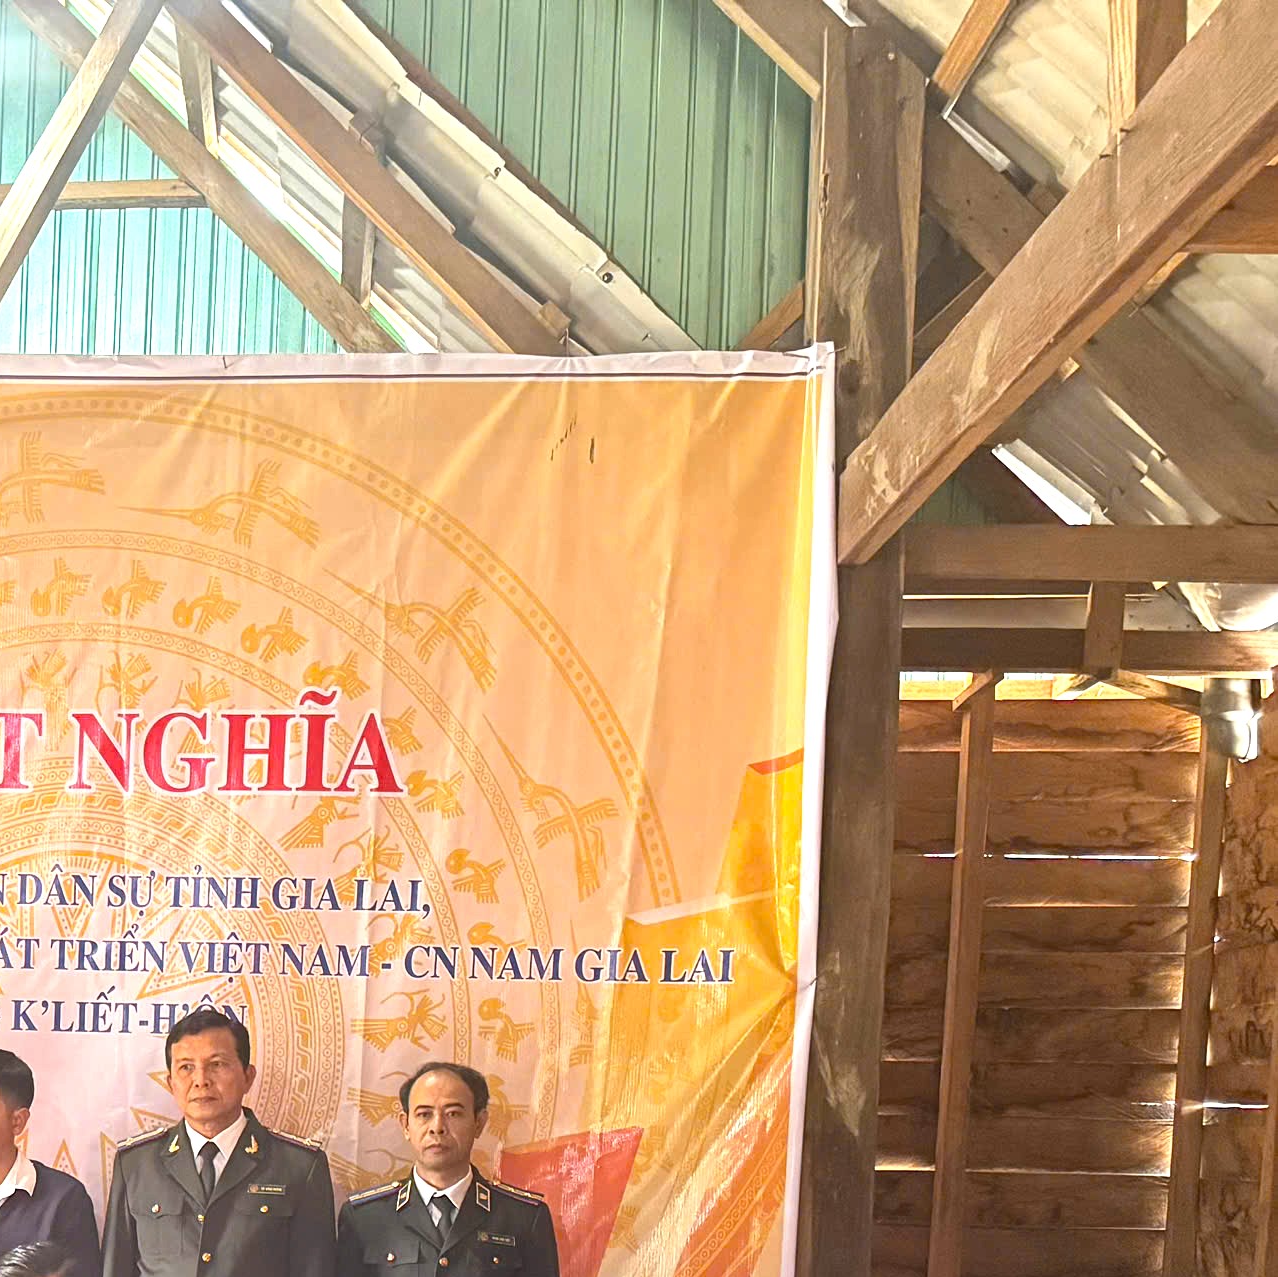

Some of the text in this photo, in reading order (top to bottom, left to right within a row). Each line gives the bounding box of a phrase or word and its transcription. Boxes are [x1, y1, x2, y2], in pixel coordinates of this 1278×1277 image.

[68, 689, 407, 793] NGHĨA
[17, 863, 98, 908] DÂN
[107, 869, 156, 917] SỰ
[165, 865, 261, 909] TỈNH
[271, 877, 342, 912] GIA
[352, 879, 431, 919] LAI,
[50, 923, 168, 973] TRIỂN
[178, 933, 270, 983] VIỆT
[279, 942, 371, 978] NAM
[405, 945, 458, 979] CN
[470, 946, 563, 982] NAM
[575, 948, 649, 982] GIA
[660, 949, 735, 983] LAI
